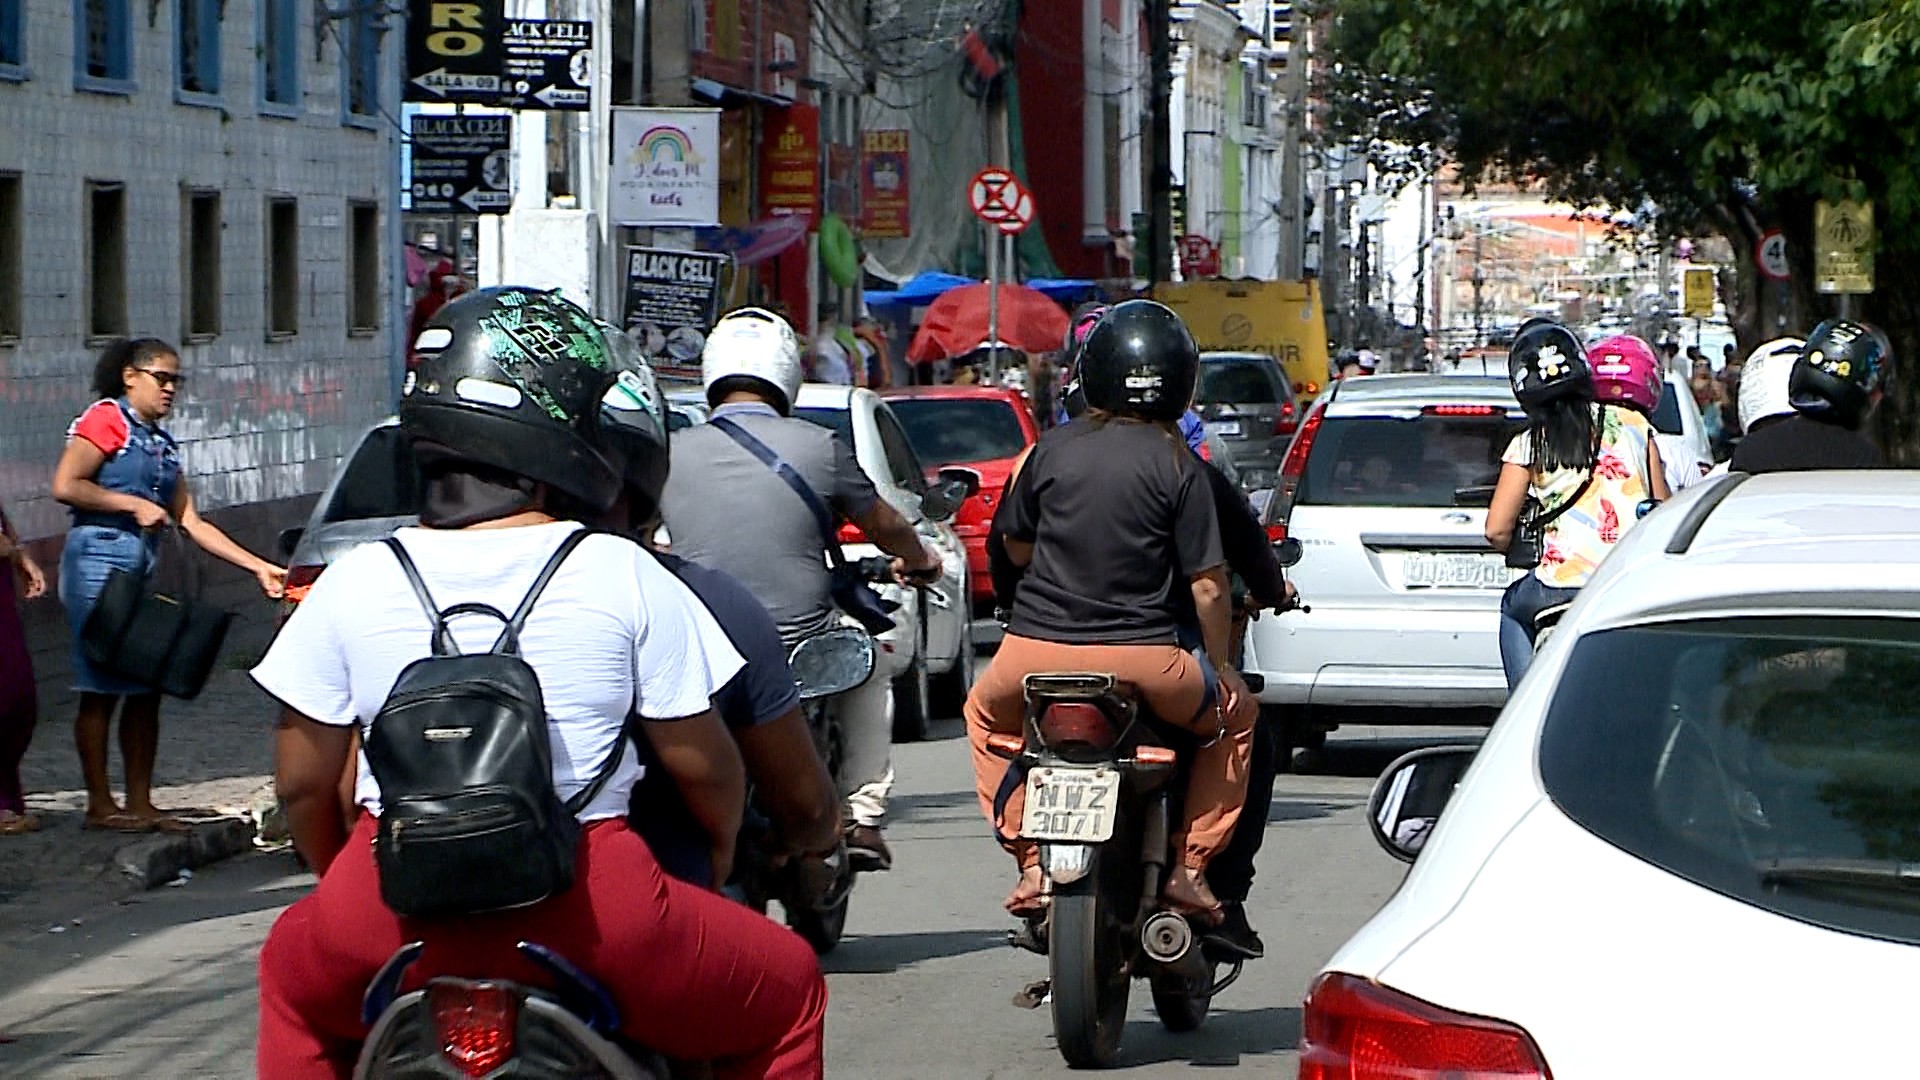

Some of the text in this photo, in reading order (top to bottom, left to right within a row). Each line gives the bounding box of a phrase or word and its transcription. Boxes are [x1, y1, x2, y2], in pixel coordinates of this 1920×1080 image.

[503, 22, 589, 39] ACK CELL
[424, 75, 463, 86] SALA
[412, 118, 464, 134] BLACK
[630, 253, 714, 283] BLACK CELL
[1039, 783, 1108, 810] NWZ
[1031, 811, 1103, 836] 3071
